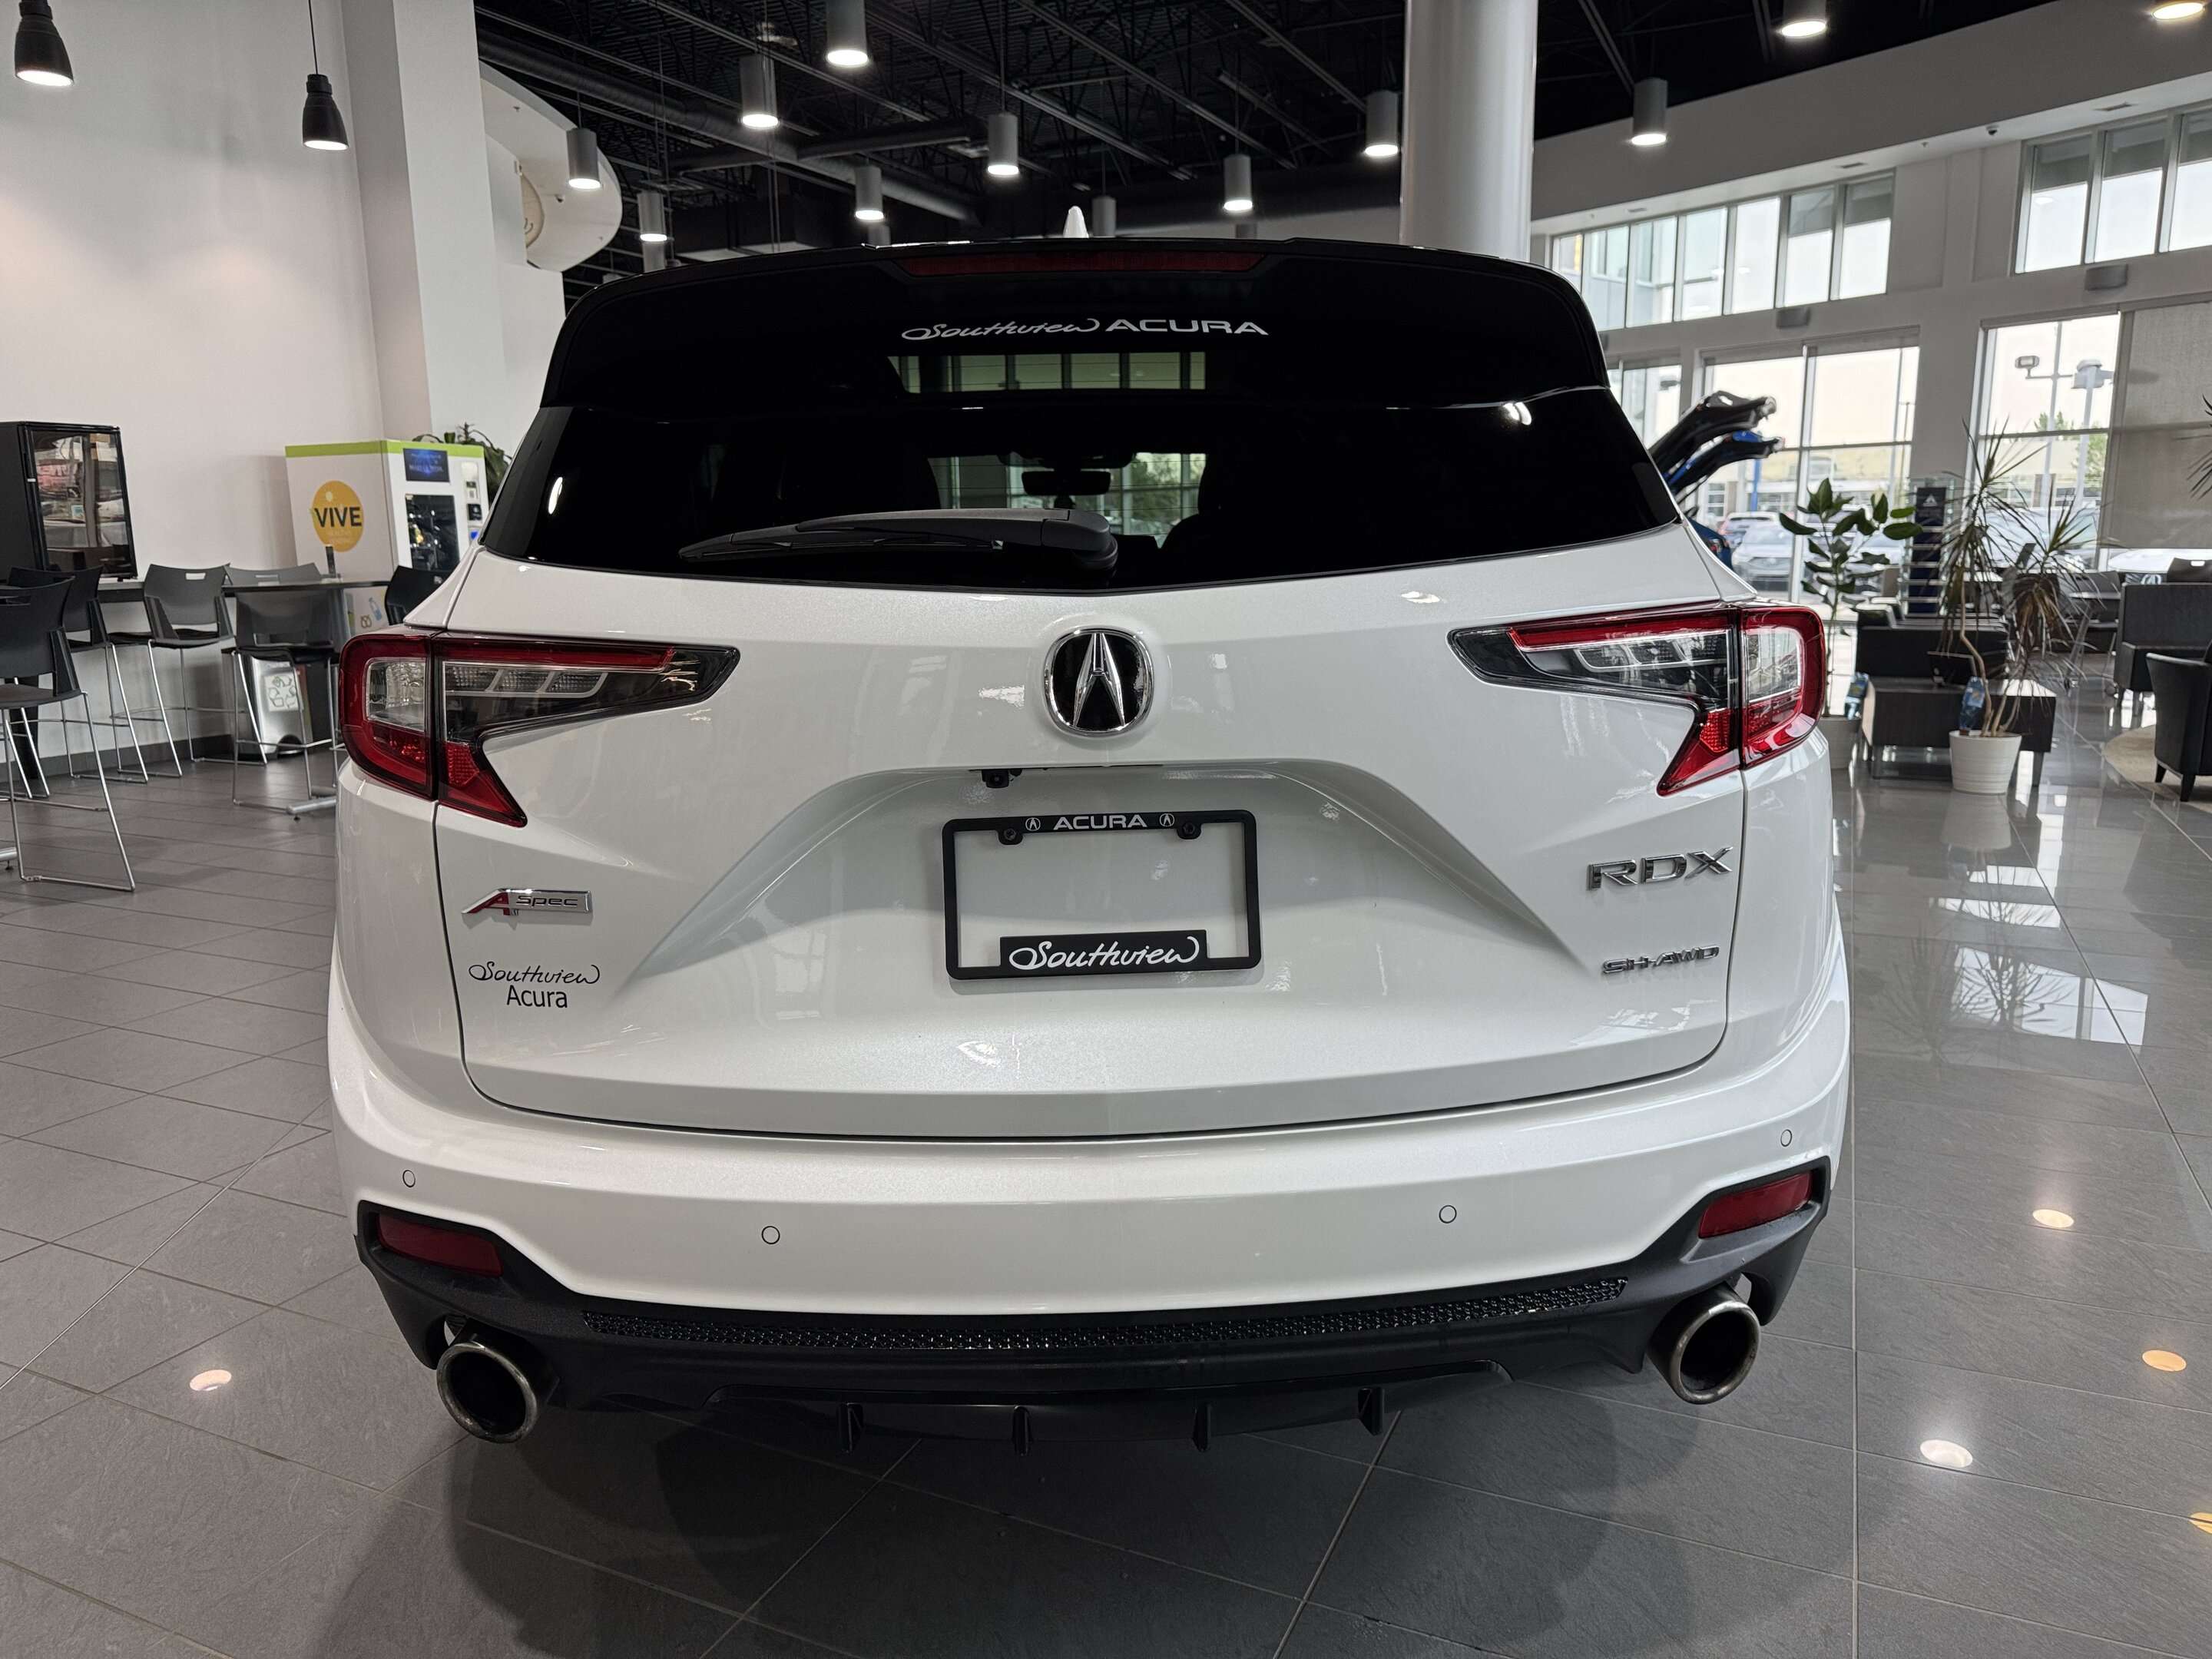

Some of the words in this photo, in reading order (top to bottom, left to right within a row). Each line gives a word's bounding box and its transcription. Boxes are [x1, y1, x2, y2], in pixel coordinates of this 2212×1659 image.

[901, 317, 1100, 340] Southview
[1104, 319, 1269, 336] ACURA
[313, 506, 362, 528] VIVE
[1053, 813, 1147, 830] ACURA
[1586, 846, 1734, 892] RDX
[1008, 935, 1200, 970] Southview
[468, 961, 601, 985] Southview
[506, 985, 568, 1008] Acura
